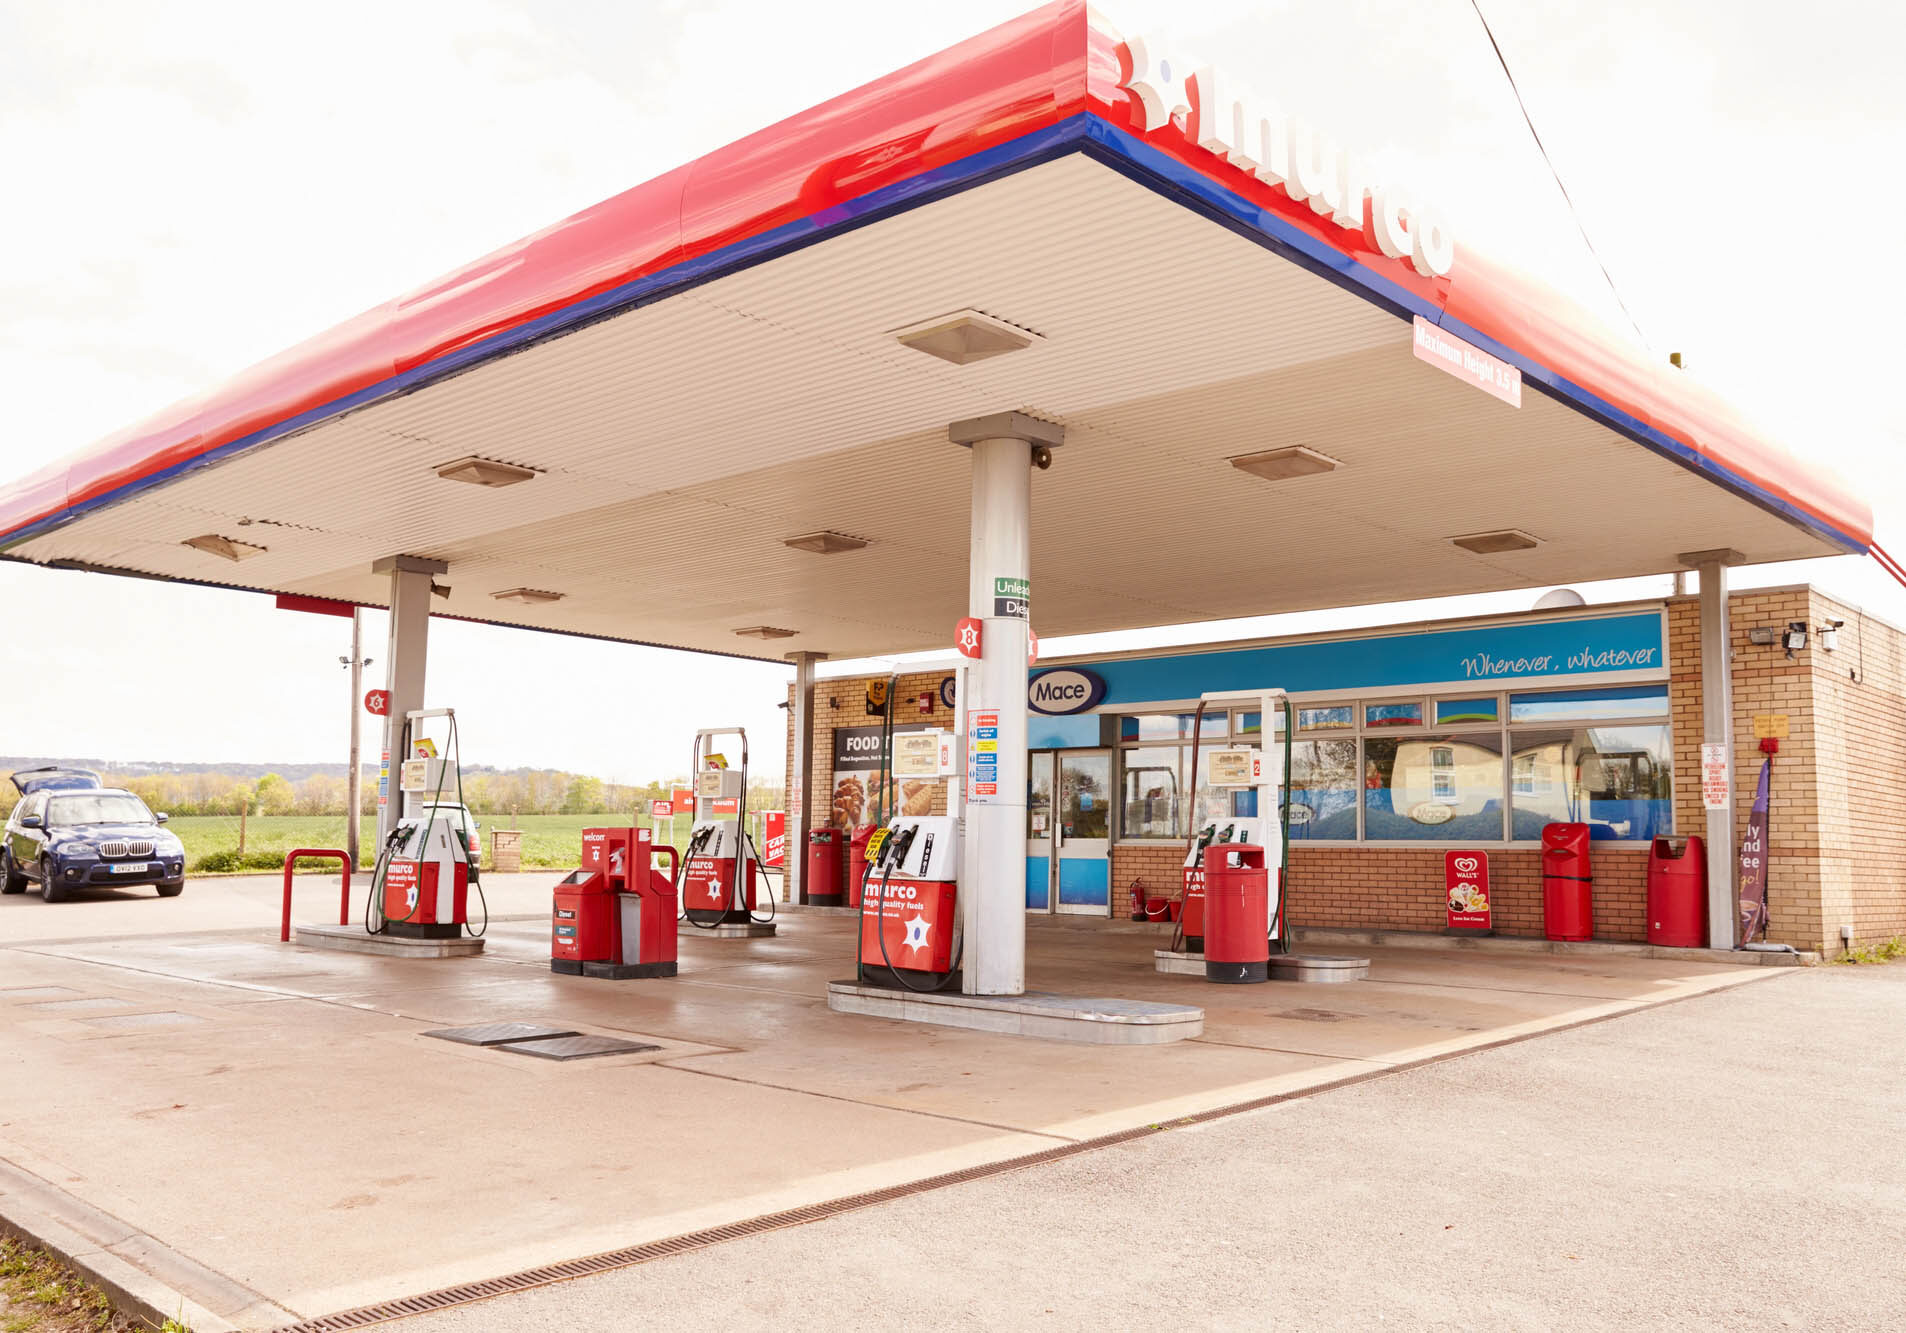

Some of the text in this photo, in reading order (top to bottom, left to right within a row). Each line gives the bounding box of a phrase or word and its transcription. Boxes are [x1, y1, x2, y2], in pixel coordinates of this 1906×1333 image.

[1197, 66, 1453, 277] murco
[1415, 324, 1463, 367] Maximum
[1463, 349, 1495, 384] Height
[965, 629, 974, 646] 8
[1567, 645, 1657, 670] whatever
[1035, 681, 1085, 702] Mace
[372, 697, 380, 707] 6
[846, 736, 880, 752] FOOD
[921, 833, 933, 873] Diesel
[388, 864, 413, 874] murco
[864, 883, 917, 900] murco
[863, 898, 879, 909] high
[907, 902, 924, 910] fuels
